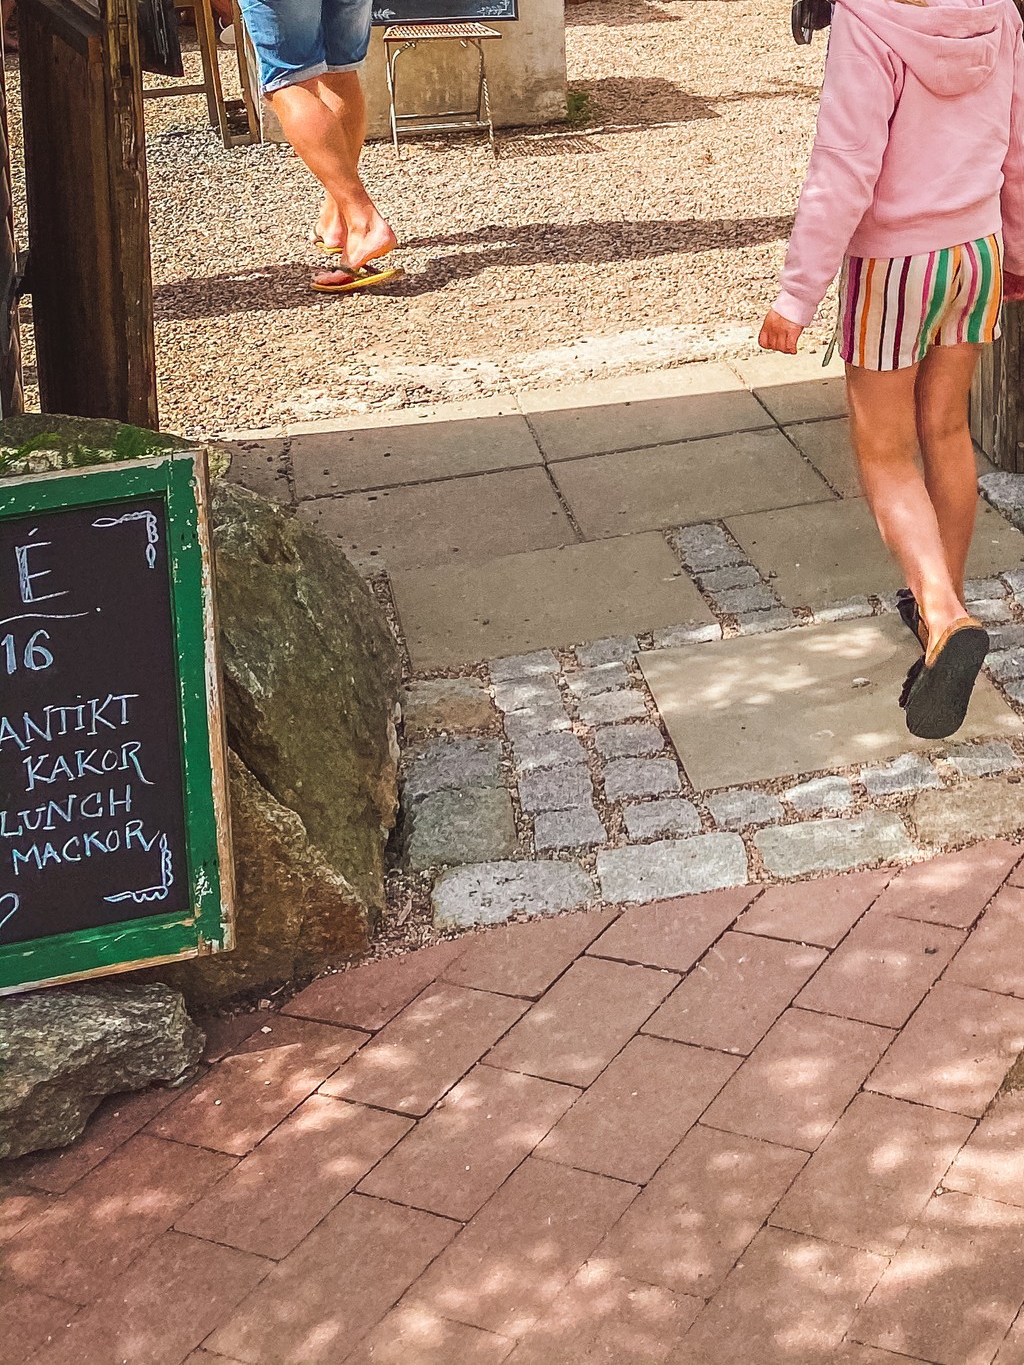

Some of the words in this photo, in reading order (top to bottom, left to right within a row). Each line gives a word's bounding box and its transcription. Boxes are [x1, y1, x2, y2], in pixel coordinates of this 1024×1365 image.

[0, 629, 54, 675] 16
[22, 741, 156, 792] KAKOR
[0, 784, 132, 837] LUNCH
[12, 819, 160, 876] MACKOR
